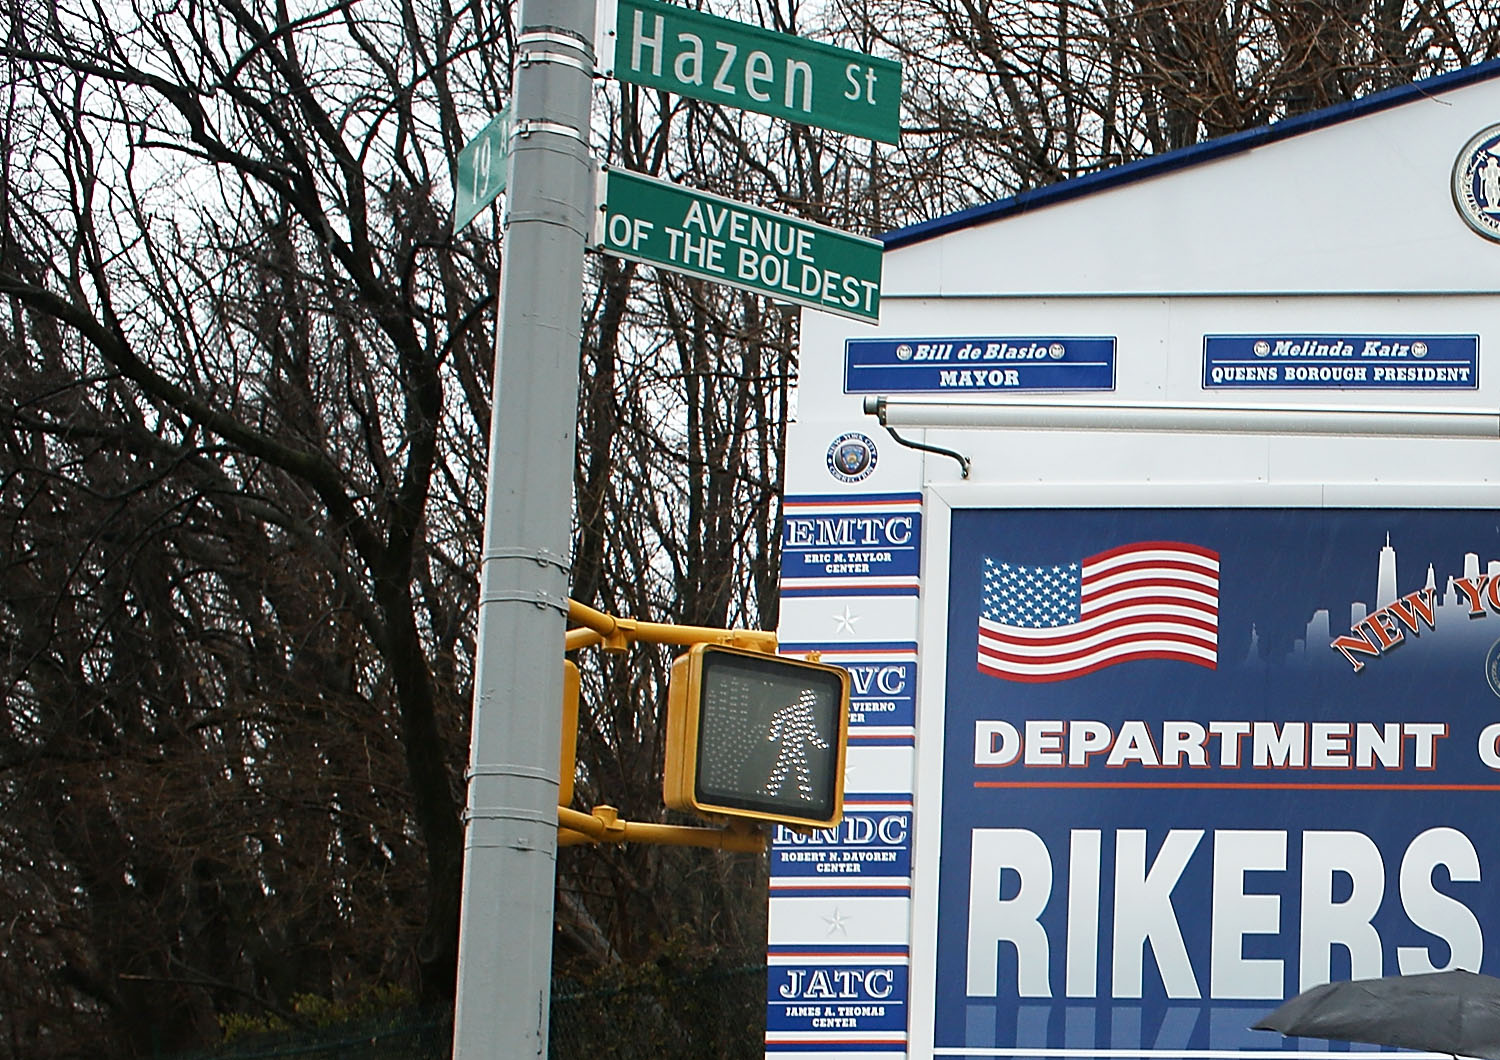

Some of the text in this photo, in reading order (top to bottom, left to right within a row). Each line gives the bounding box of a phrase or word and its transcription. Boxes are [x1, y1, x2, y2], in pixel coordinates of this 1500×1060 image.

[631, 10, 878, 113] Hazen St
[472, 136, 491, 205] 19
[683, 200, 815, 263] AVENUE
[609, 214, 878, 312] OF THE BOLDEST
[913, 343, 1047, 360] Bill de Blasio
[1272, 341, 1411, 357] Melinda Katz
[940, 370, 1020, 386] MAYOR
[1211, 367, 1470, 383] QUEENS BOROUGH PRESIDENT
[786, 517, 912, 546] EMTC
[804, 554, 831, 563] ERIC
[848, 552, 892, 562] TAYLOR
[825, 563, 870, 573] CENTER
[1330, 586, 1439, 673] NEW
[848, 666, 906, 695] VC
[853, 702, 896, 712] VIERNO
[974, 720, 1448, 770] DEPARTMENT
[781, 852, 826, 862] ROBERT
[843, 851, 897, 861] DAVOREN
[816, 863, 861, 873] CENTER
[965, 827, 1484, 1000] RIKERS
[779, 968, 893, 999] JATC
[785, 1006, 822, 1017] JAMES
[838, 1006, 885, 1017] THOMAS
[812, 1018, 857, 1028] CENTER
